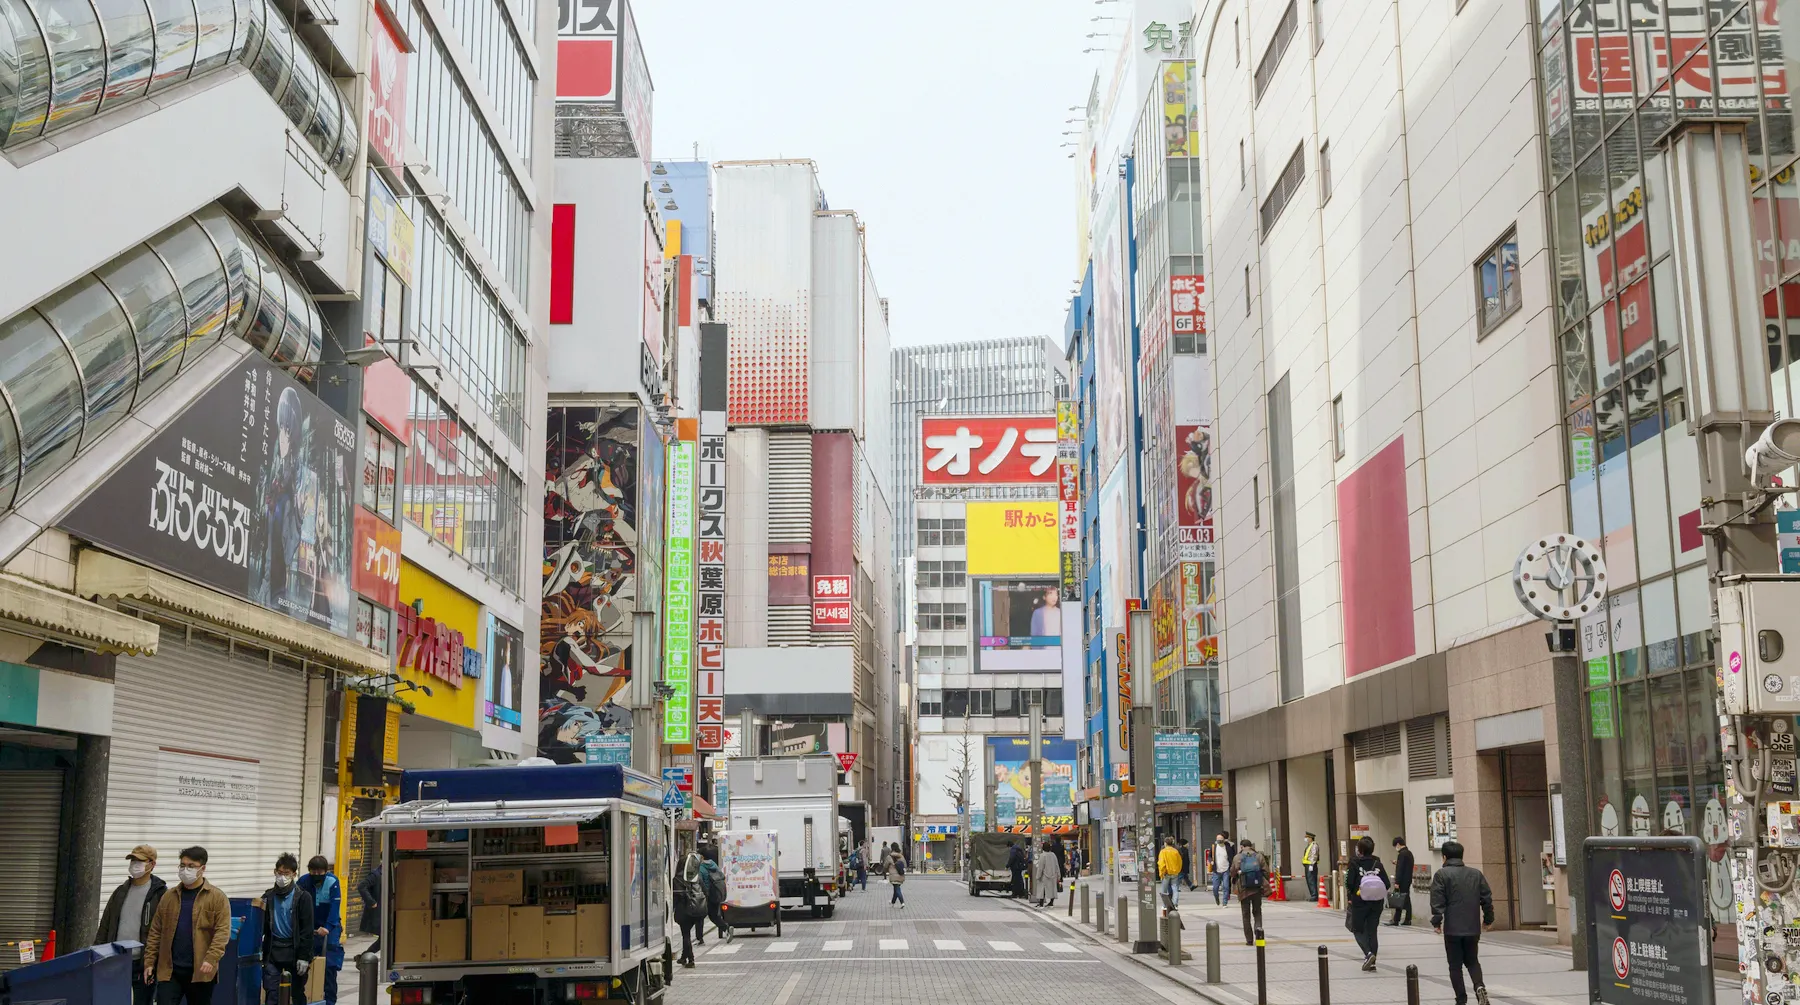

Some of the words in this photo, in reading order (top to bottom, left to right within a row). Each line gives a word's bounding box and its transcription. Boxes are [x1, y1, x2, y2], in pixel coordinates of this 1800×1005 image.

[1176, 318, 1192, 329] 6F
[248, 368, 257, 427] 令和初の
[262, 370, 272, 466] 待たせたな。
[1060, 450, 1077, 459] 麻雀
[1004, 510, 1056, 528] 駅から
[1065, 502, 1077, 539] 耳かき
[1180, 528, 1210, 543] 04.03
[365, 536, 399, 585] アイフル
[769, 556, 788, 565] 本店
[769, 566, 807, 576] 総合家電
[817, 580, 848, 594] 免税
[816, 608, 848, 619] 면세점
[1774, 734, 1791, 743] JS
[1627, 878, 1664, 893] 路上喫煙禁止
